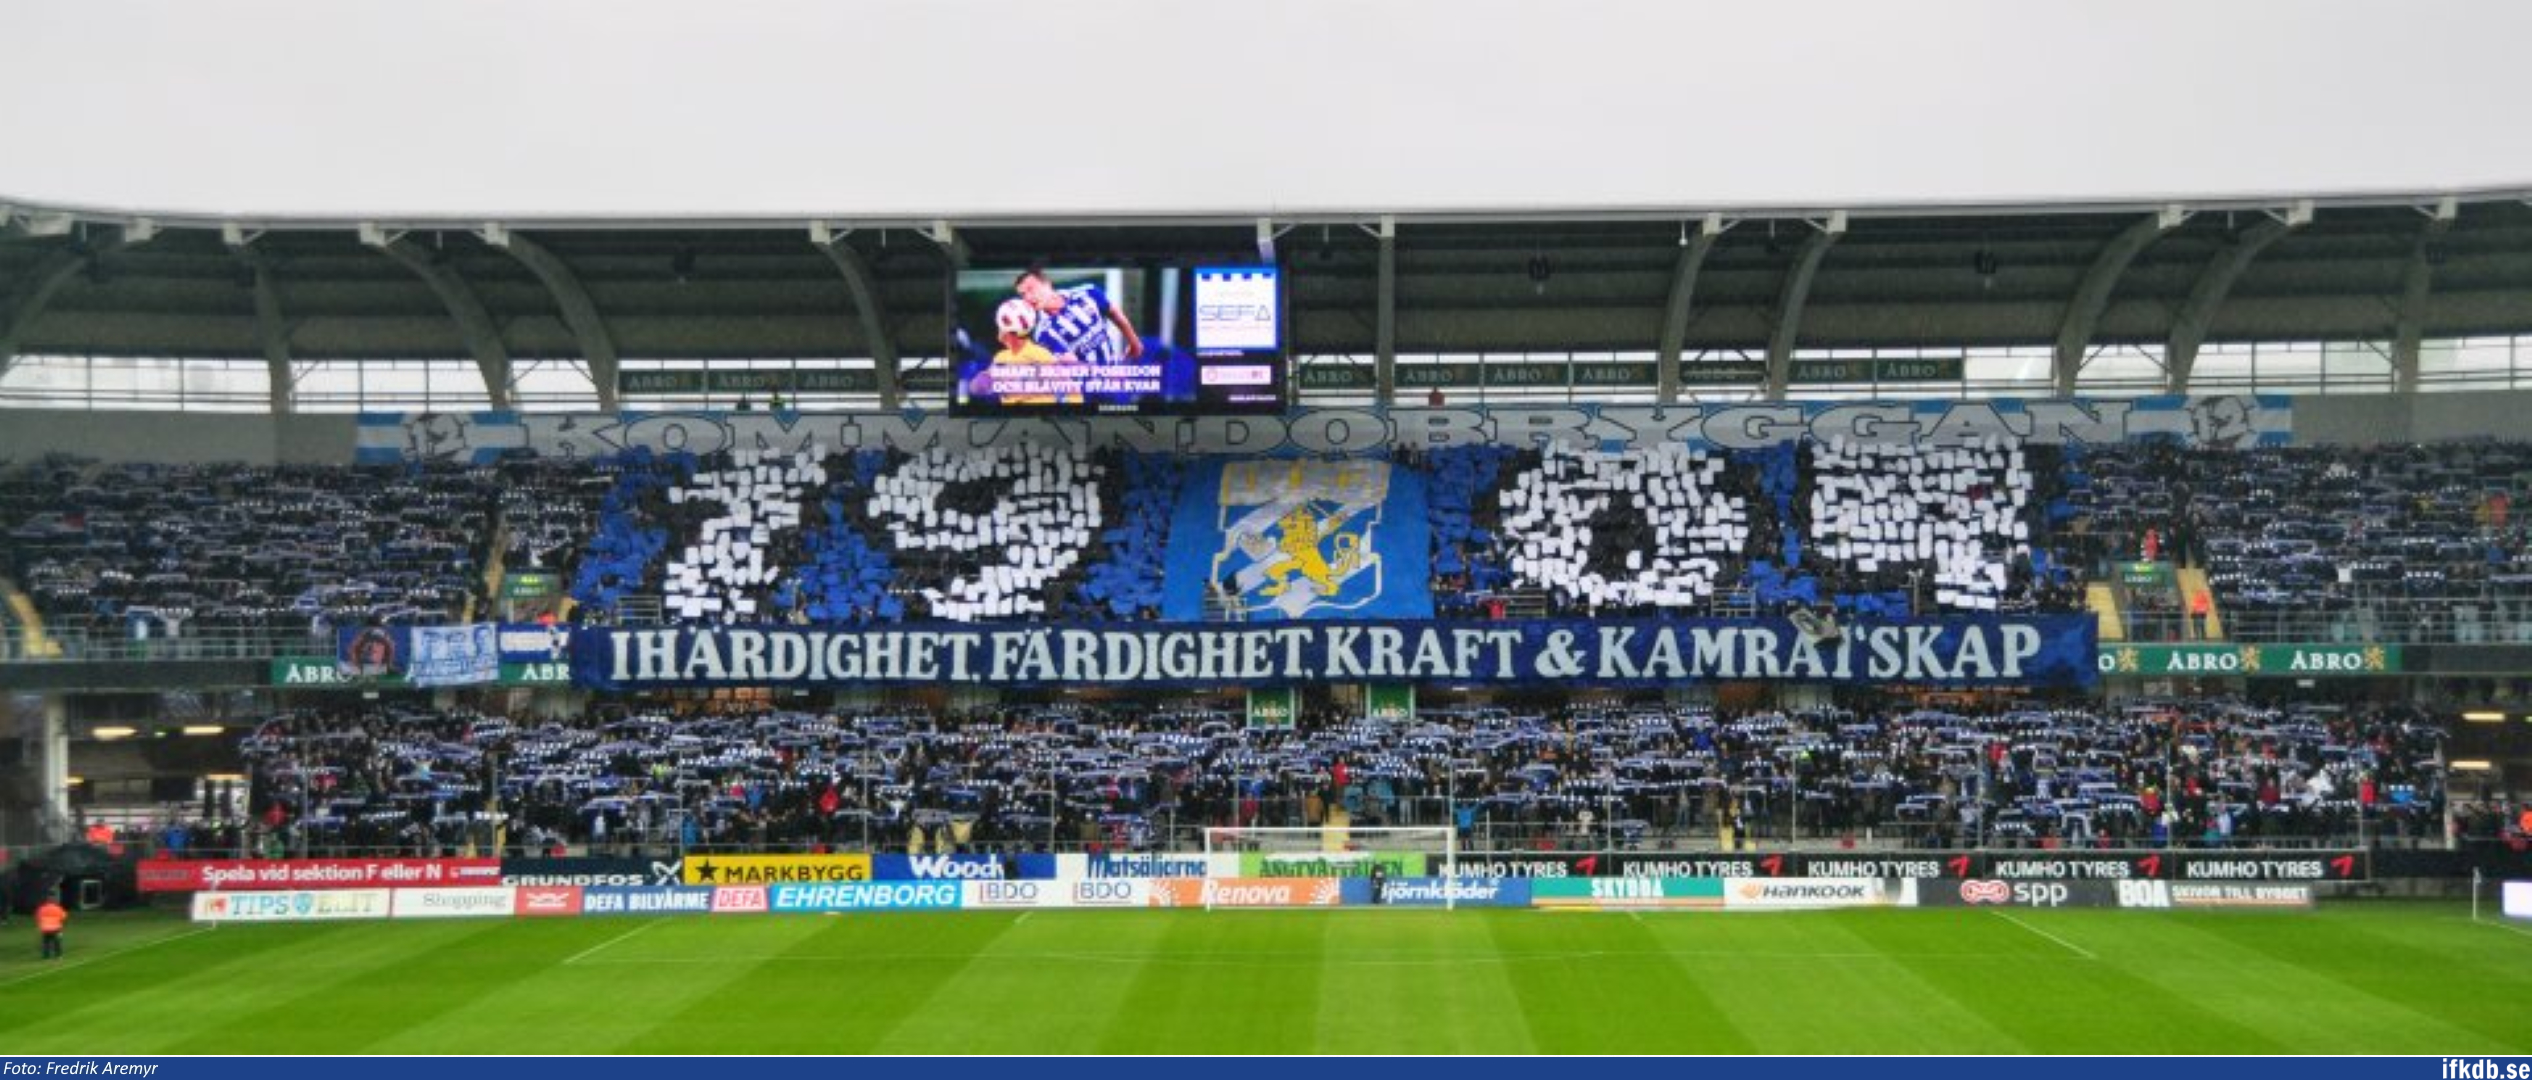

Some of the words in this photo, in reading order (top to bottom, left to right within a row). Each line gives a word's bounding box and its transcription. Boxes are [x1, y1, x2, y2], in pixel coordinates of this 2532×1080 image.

[1325, 626, 1522, 678] KRAFT
[1534, 628, 1588, 678] &
[2167, 650, 2237, 671] ÅBRO
[2290, 649, 2362, 671] ÅBRO
[202, 865, 255, 885] Spela
[259, 864, 290, 881] vid
[294, 864, 362, 881] sektion
[366, 864, 378, 880] F
[382, 864, 421, 880] eller
[426, 864, 442, 879] N
[724, 865, 863, 883] MARKBYGG
[1509, 861, 1569, 878] TYRES
[1623, 861, 1691, 878] KUMHO
[1694, 861, 1754, 878] TYRES
[1808, 861, 1878, 878] KUMHO
[1879, 861, 1940, 878] TYRES
[1995, 861, 2065, 878] KUMHO
[2069, 861, 2131, 878] TYRES
[2187, 861, 2258, 878] KUMHO
[2260, 861, 2323, 878] TYRES
[502, 875, 643, 887] GRUNDFOS
[987, 882, 1038, 899] BDO
[1080, 881, 1131, 899] BDO
[584, 892, 625, 911] DEFA
[719, 889, 763, 908] DEFA
[777, 884, 956, 908] EHRENBORG
[1201, 880, 1291, 904] Renova
[2013, 882, 2068, 907] spp
[2119, 880, 2170, 907] BOA
[230, 896, 289, 915] TIPS
